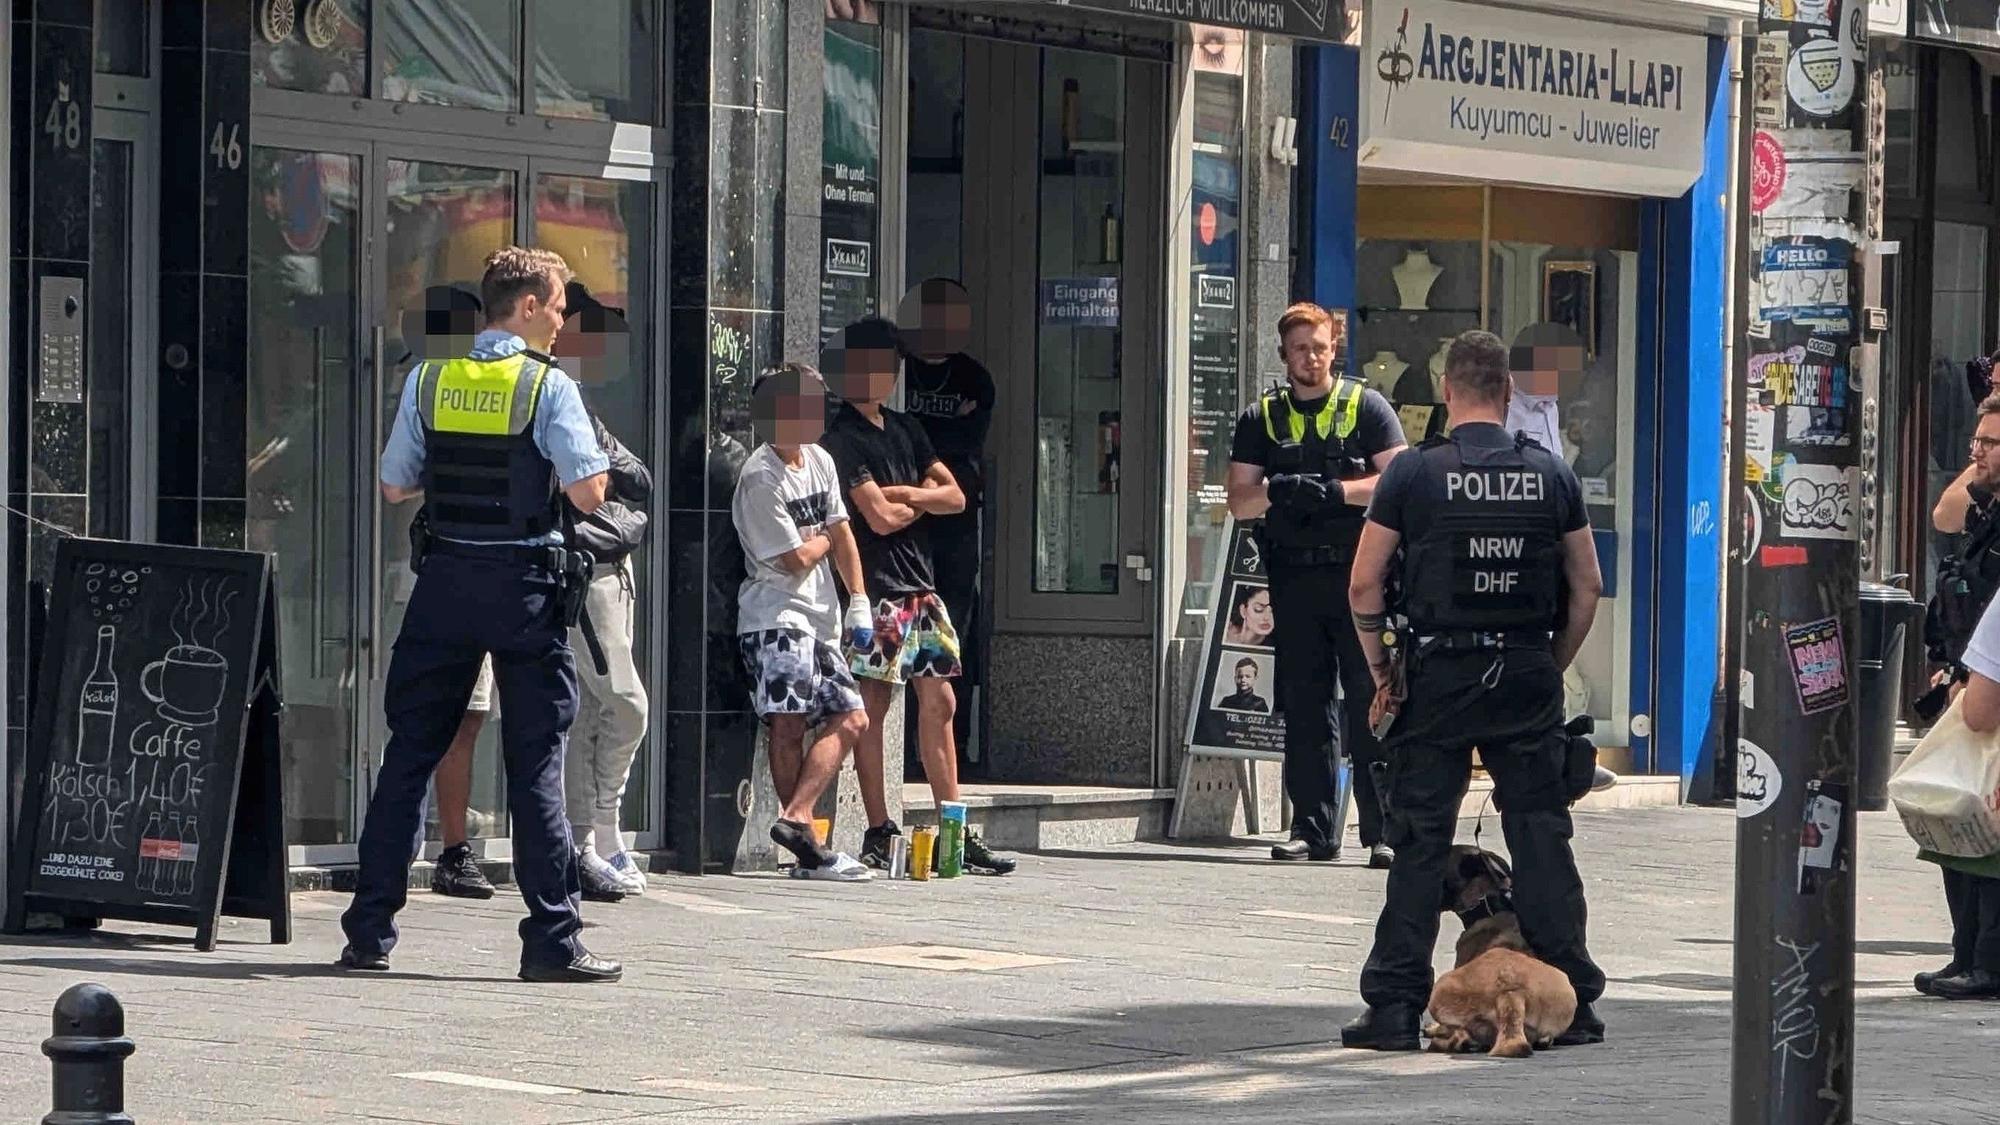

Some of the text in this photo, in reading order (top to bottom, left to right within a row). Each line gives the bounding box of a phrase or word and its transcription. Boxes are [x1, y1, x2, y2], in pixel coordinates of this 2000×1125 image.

[1200, 0, 1284, 28] WILLKOMMEN
[1417, 22, 1684, 111] ARGJENTARIA-LLAPI
[45, 99, 81, 149] 48
[1330, 115, 1349, 149] 42
[1450, 96, 1552, 141] Kuyumcu
[1574, 110, 1661, 150] Juwelier
[210, 121, 242, 170] 46
[835, 163, 865, 181] Mit und
[824, 183, 875, 204] Ohne Termin
[1776, 248, 1828, 264] HELLO
[1054, 284, 1118, 302] Eingang
[1045, 301, 1121, 318] freihalten
[440, 387, 508, 413] POLIZEI
[1446, 471, 1544, 501] POLIZEI
[1469, 537, 1525, 559] NRW
[1474, 571, 1520, 593] DHF
[130, 721, 202, 759] Caffe
[51, 760, 122, 798] Kölsch
[125, 756, 219, 811] 1,40€
[46, 795, 129, 849] 1,30€
[67, 855, 93, 866] DAZU
